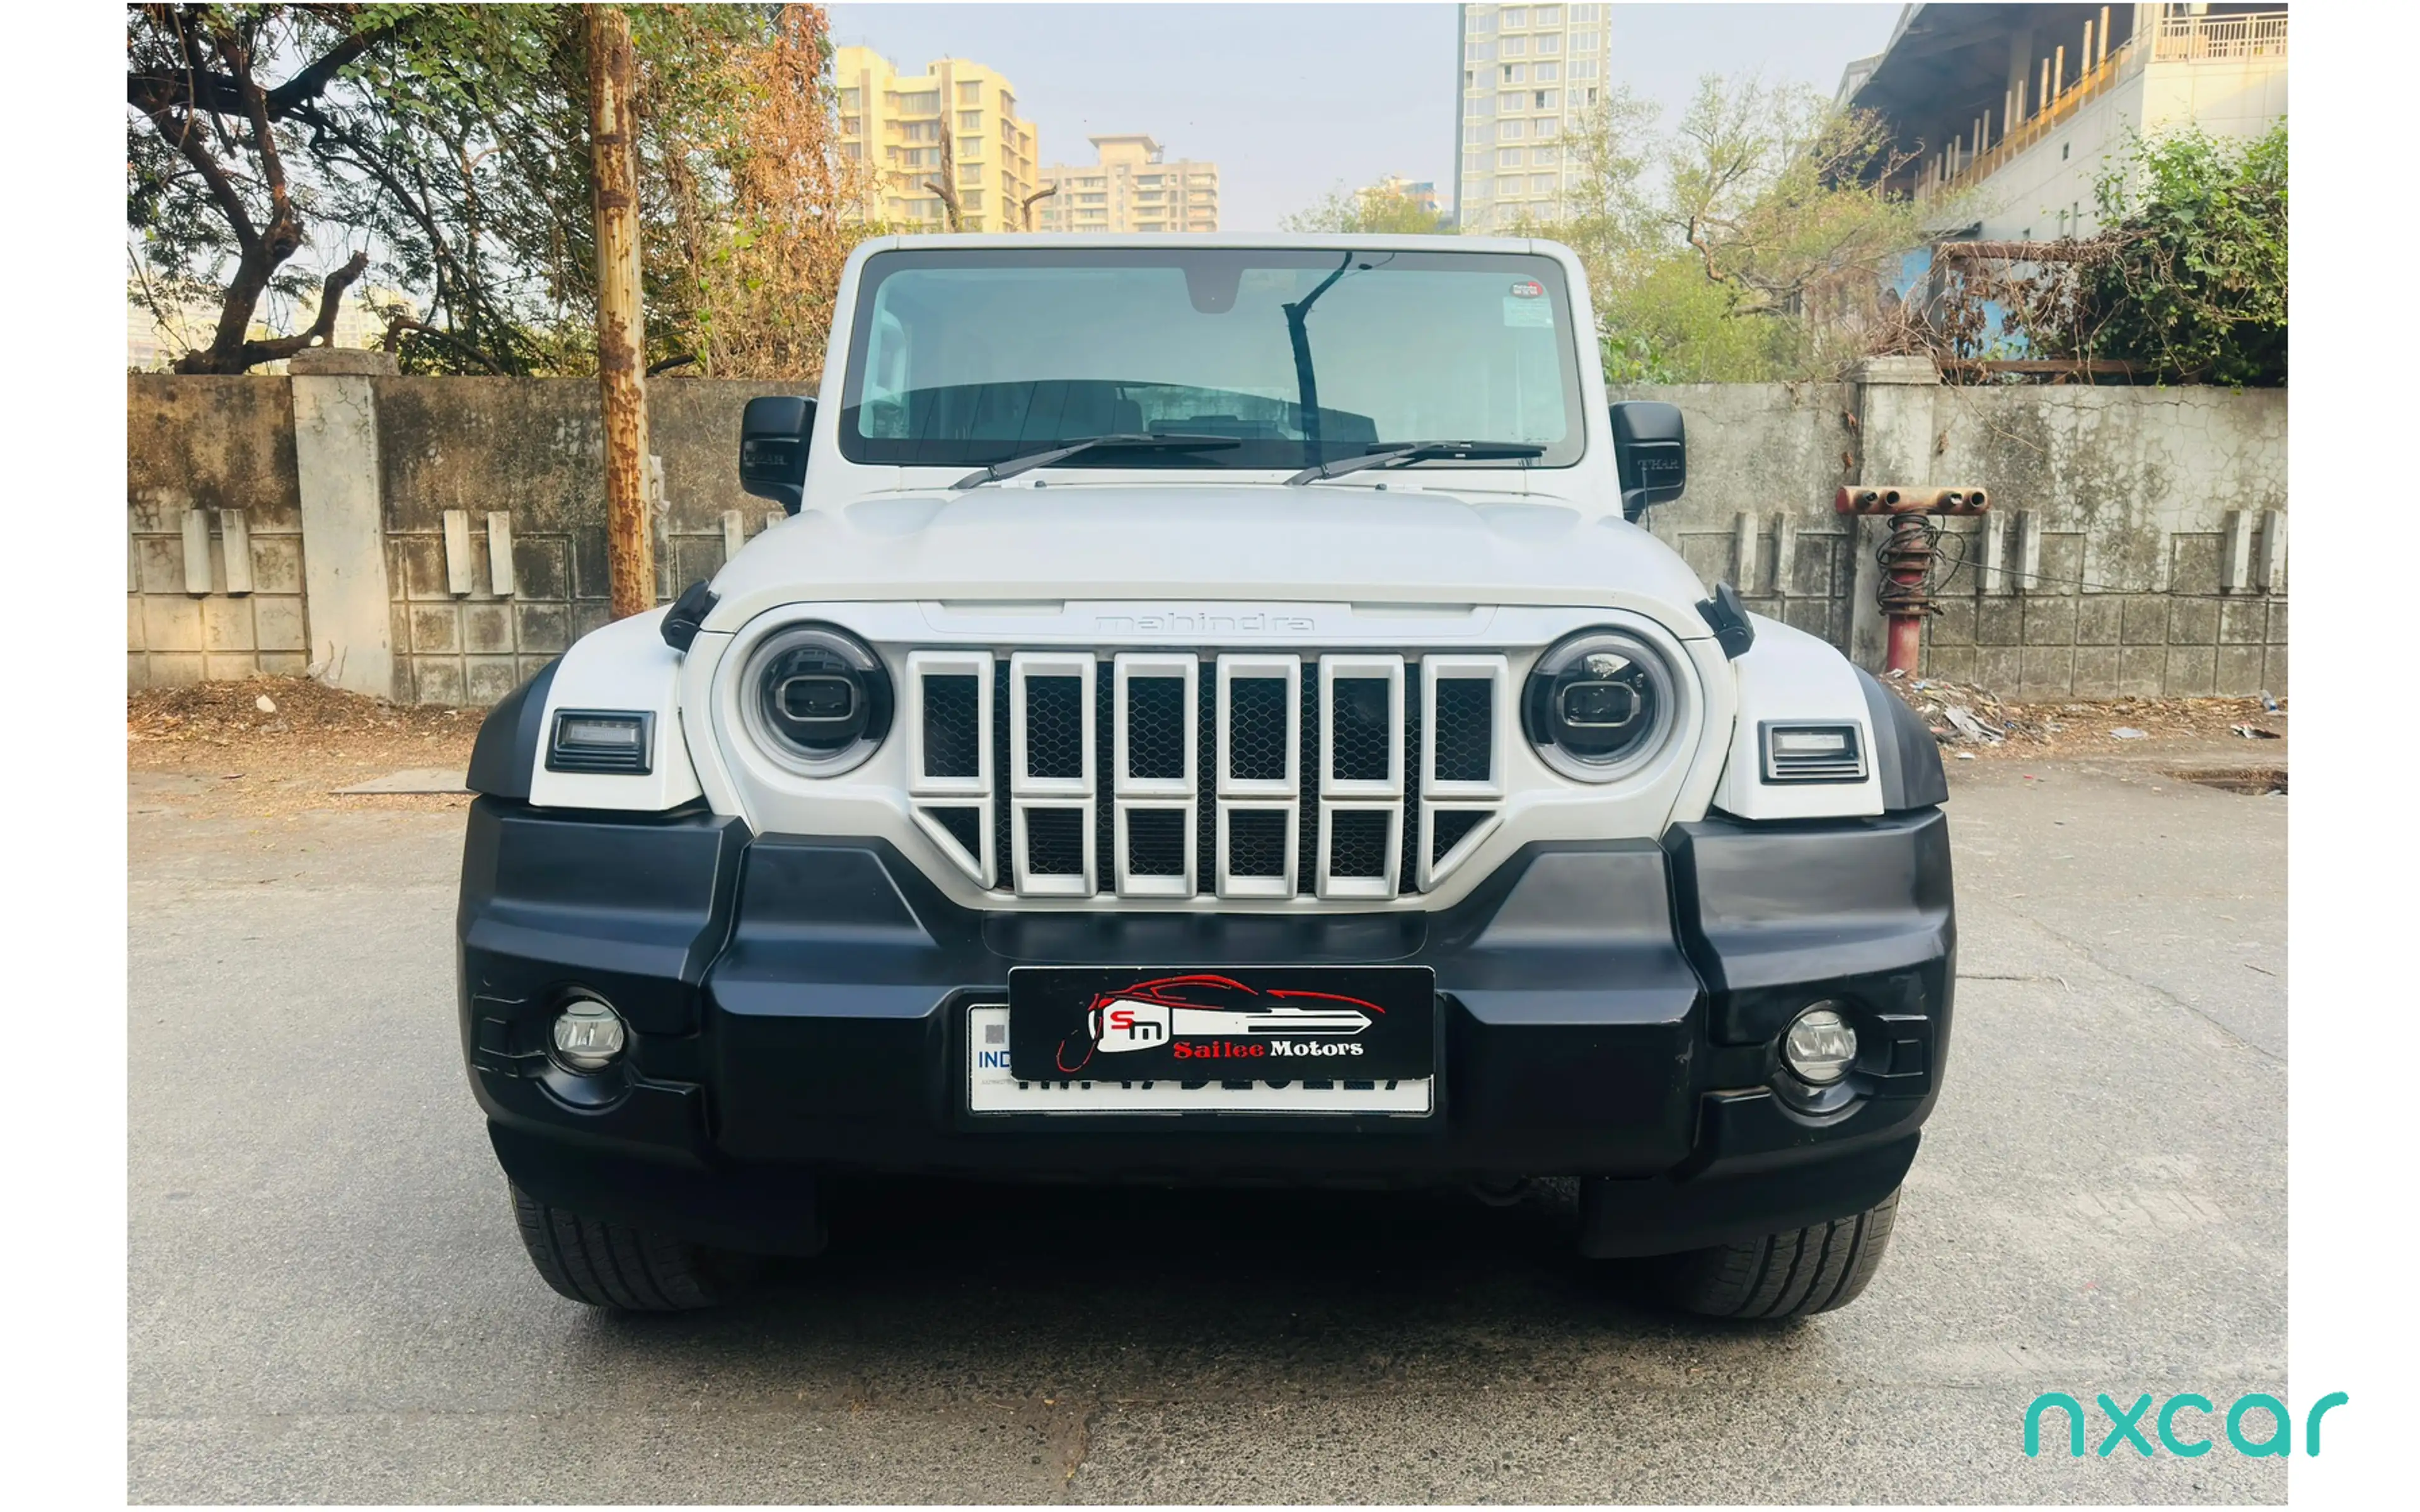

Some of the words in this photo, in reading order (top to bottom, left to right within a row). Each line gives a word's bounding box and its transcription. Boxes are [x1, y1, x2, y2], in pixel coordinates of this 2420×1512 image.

[1095, 612, 1315, 631] mahindra
[1173, 1040, 1265, 1059] Sailee
[1270, 1040, 1364, 1057] Motors
[978, 1051, 1010, 1068] IND
